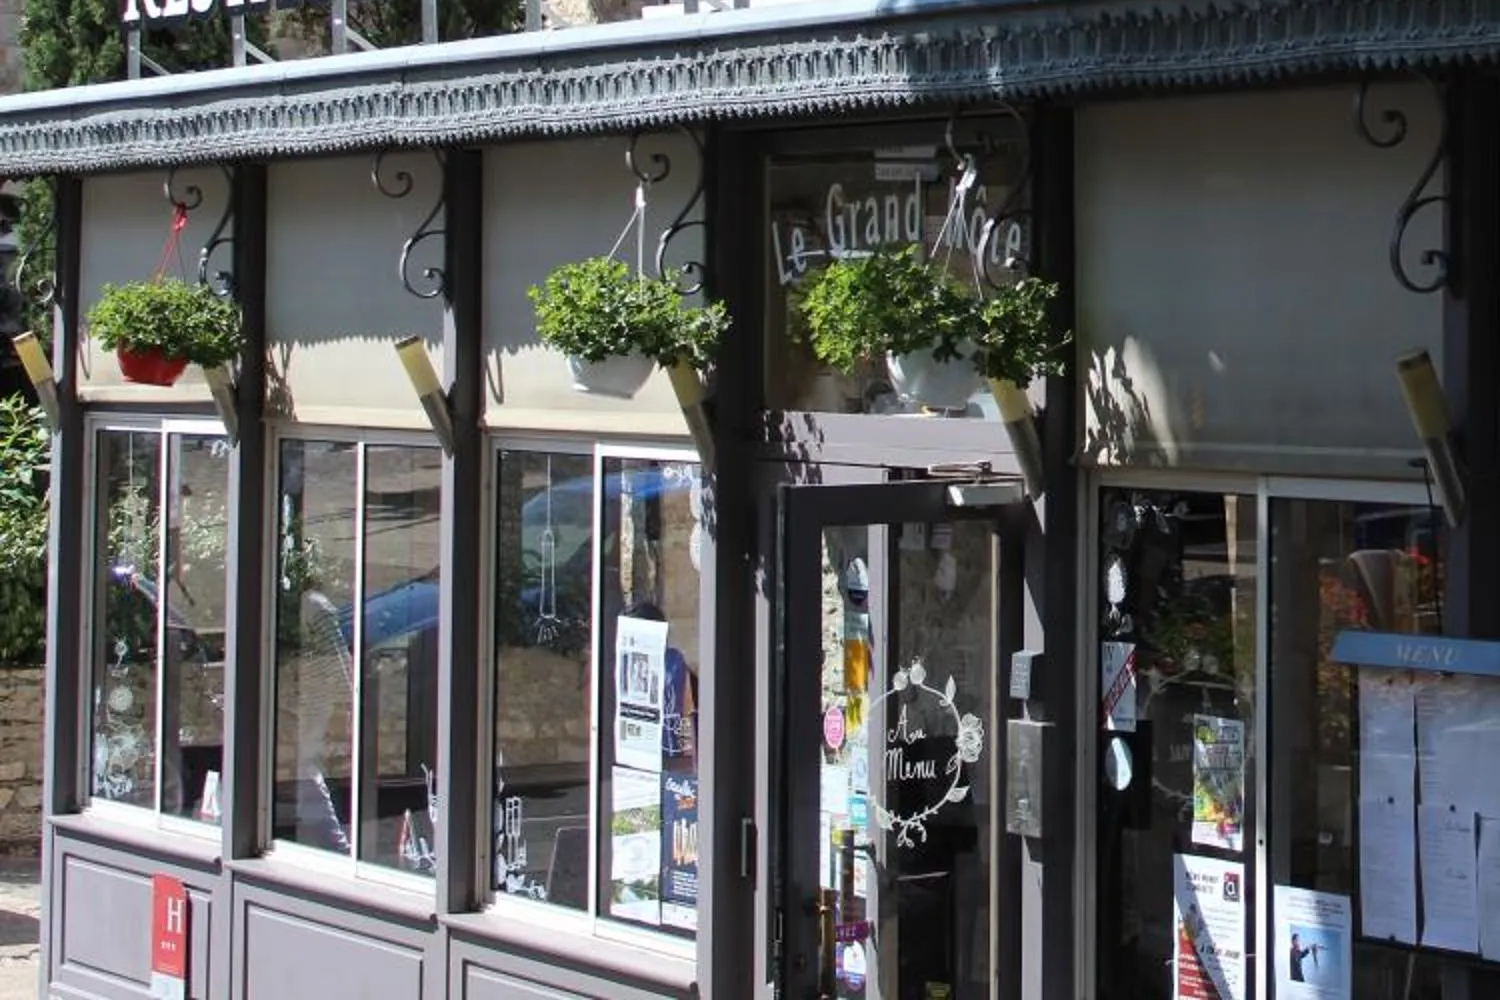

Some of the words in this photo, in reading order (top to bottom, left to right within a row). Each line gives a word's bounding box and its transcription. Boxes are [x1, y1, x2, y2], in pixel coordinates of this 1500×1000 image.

[772, 220, 807, 286] Le
[826, 172, 921, 252] Grand
[885, 748, 936, 781] Menu
[167, 896, 184, 934] H
